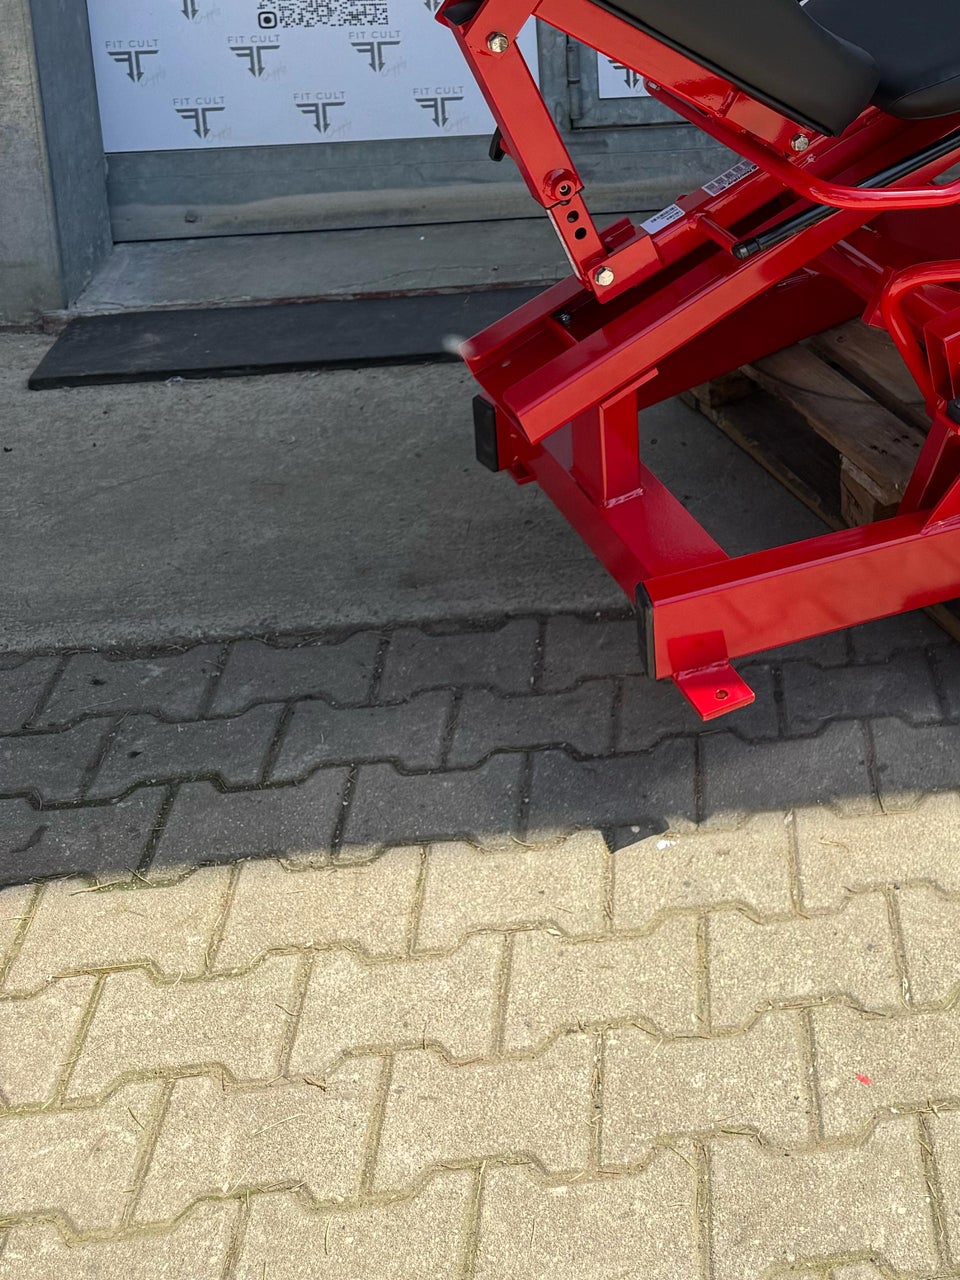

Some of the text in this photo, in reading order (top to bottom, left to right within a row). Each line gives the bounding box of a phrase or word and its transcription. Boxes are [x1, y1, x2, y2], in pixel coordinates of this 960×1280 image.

[412, 85, 464, 96] FIT CULT
[172, 95, 225, 106] FIT CULT
